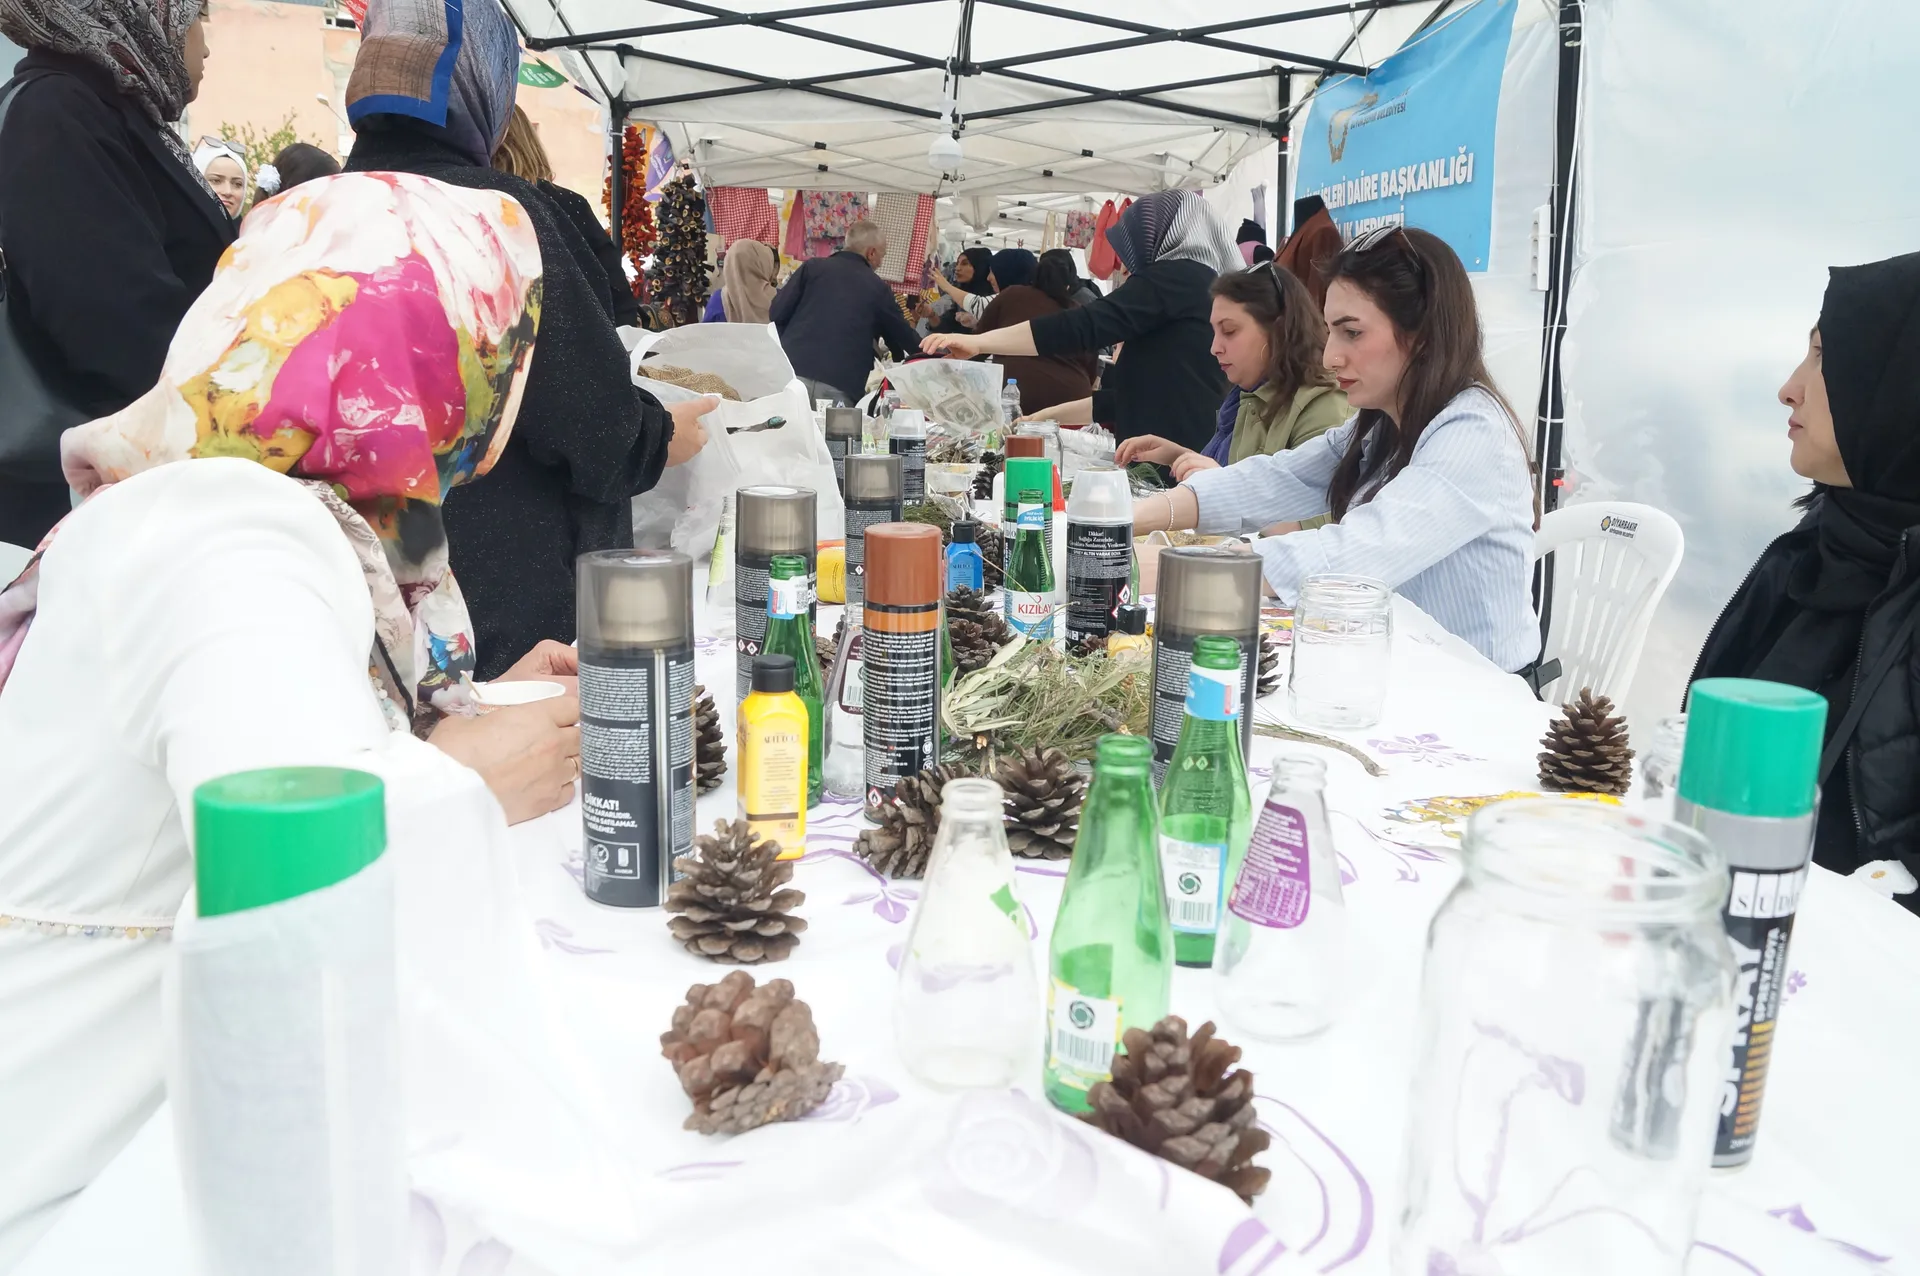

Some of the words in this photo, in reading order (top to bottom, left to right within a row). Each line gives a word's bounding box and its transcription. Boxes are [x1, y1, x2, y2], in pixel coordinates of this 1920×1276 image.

[1347, 169, 1379, 206] DAİRE
[1380, 145, 1475, 201] BAŞKANLIĞI
[1018, 603, 1052, 615] KIZILAY
[584, 792, 620, 811] DİKKAT!
[1762, 926, 1780, 970] BOYA
